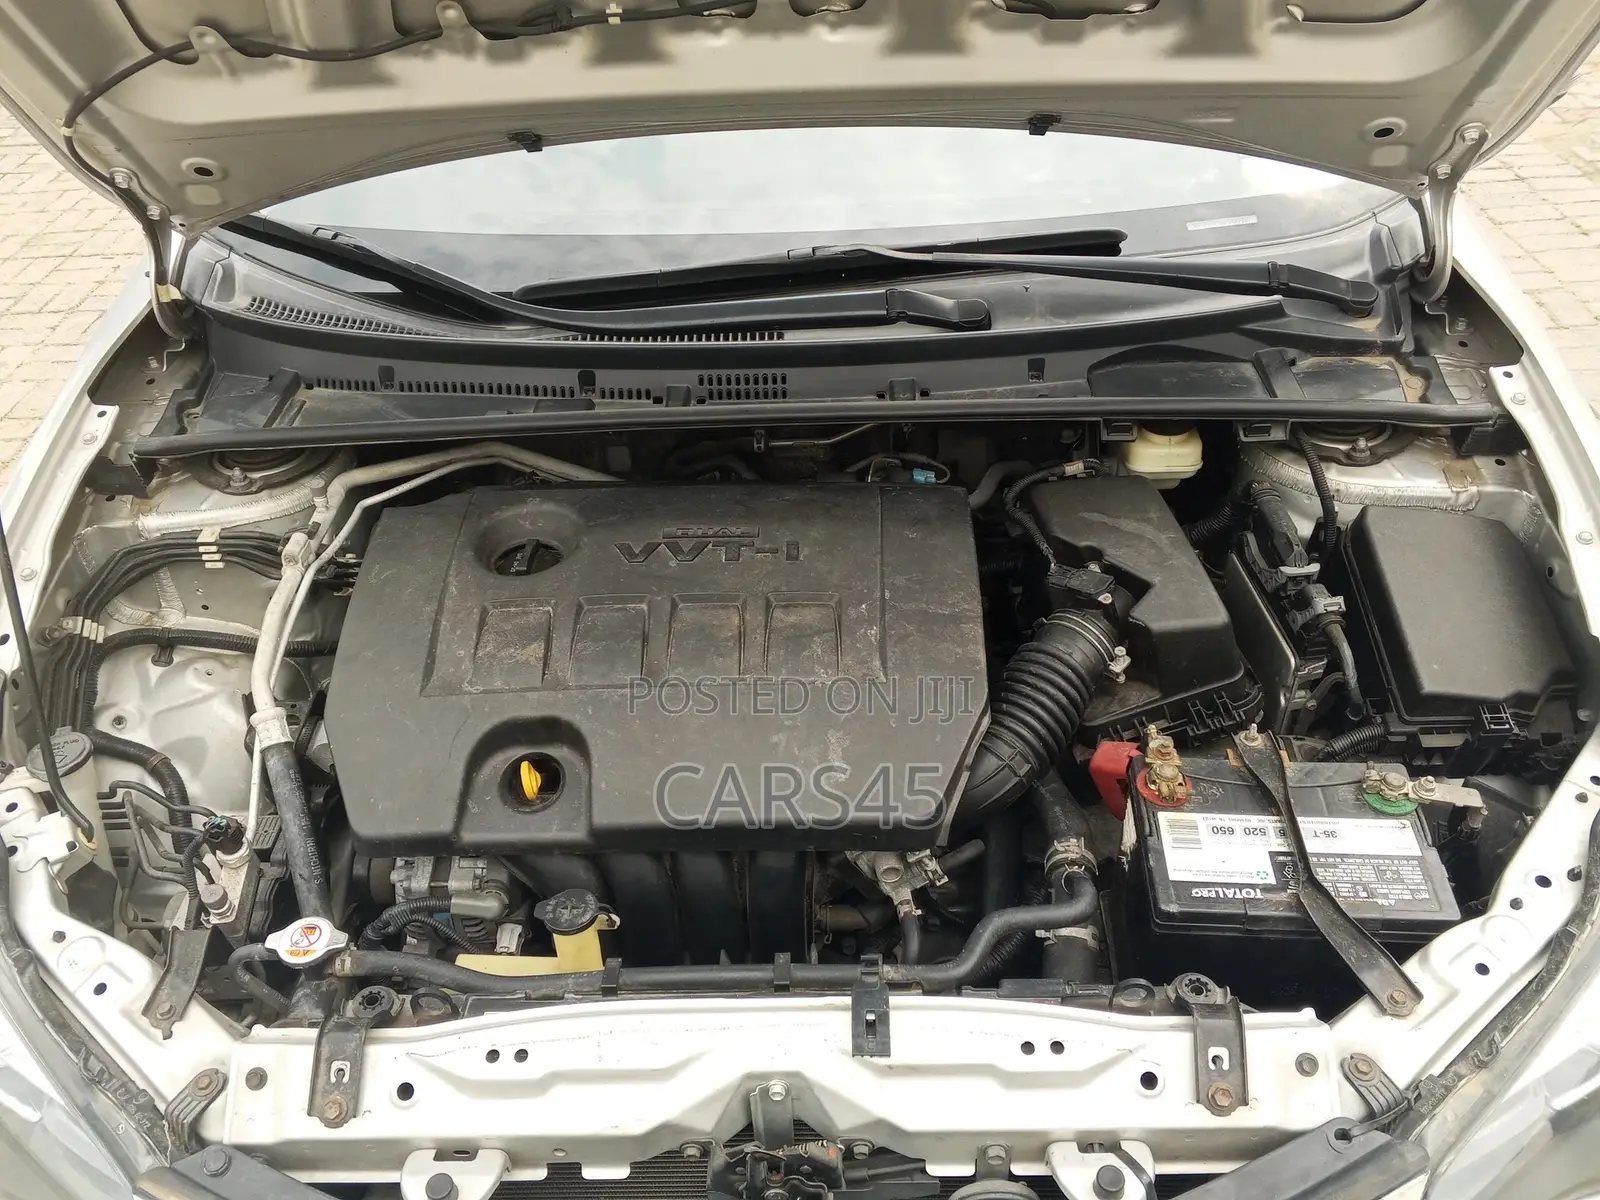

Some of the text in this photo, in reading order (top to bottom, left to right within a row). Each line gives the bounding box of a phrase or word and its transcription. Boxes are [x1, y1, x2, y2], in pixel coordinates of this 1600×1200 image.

[1211, 825, 1235, 836] 650
[1243, 826, 1267, 836] 520
[1312, 829, 1338, 839] 35-T
[1191, 887, 1264, 899] TOTALPRO
